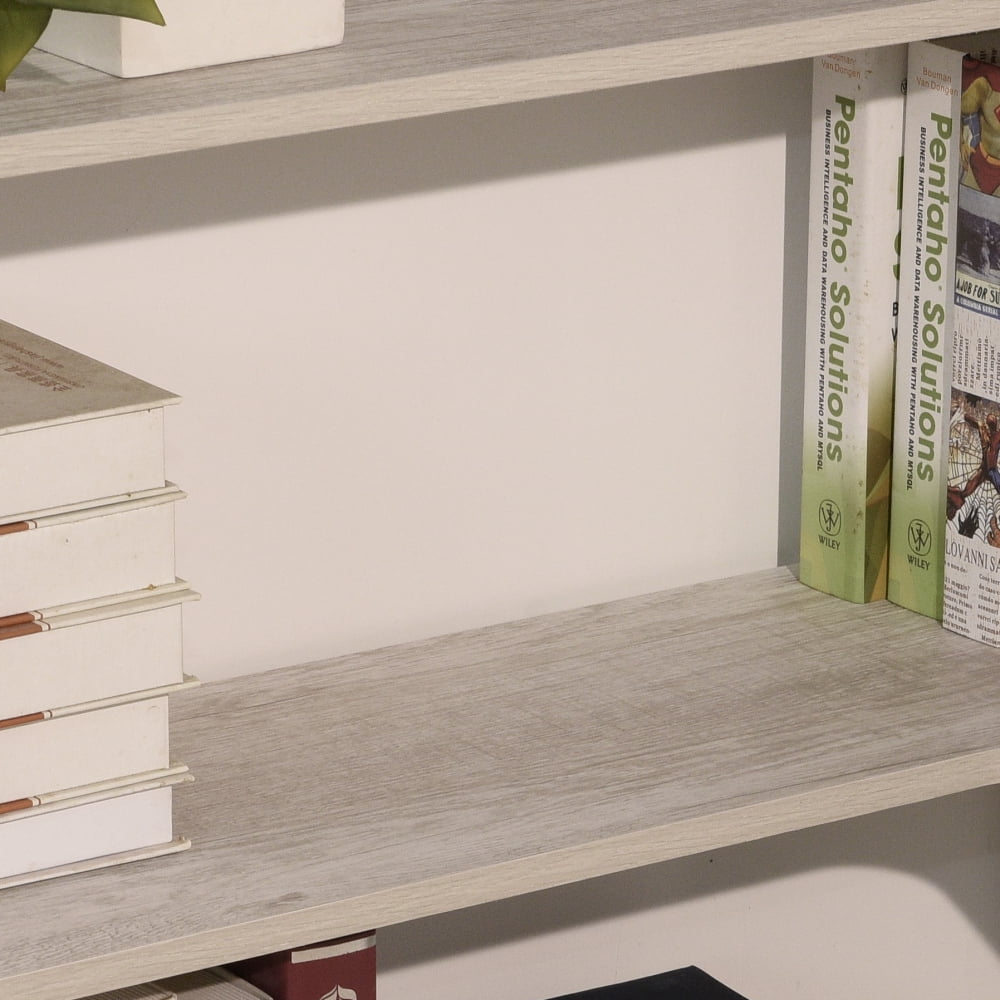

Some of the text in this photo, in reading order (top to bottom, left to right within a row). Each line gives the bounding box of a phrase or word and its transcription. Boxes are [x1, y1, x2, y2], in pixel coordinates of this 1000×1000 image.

[824, 108, 832, 156] BUSINESS
[918, 126, 926, 174] BUSINESS
[822, 158, 830, 226] INTELLIGENCE
[915, 176, 925, 245] INTELLIGENCE
[826, 94, 856, 463] Pentaho Solutions
[916, 111, 953, 483] Pentaho Solutions
[973, 285, 988, 300] FOR
[819, 276, 828, 345] WAREHOUSING
[911, 294, 921, 364] WAREHOUSING
[908, 393, 916, 436] PENTAHO
[907, 438, 915, 458] AND
[906, 460, 914, 491] MYSQL
[818, 534, 841, 550] WILEY
[907, 553, 930, 571] WILEY
